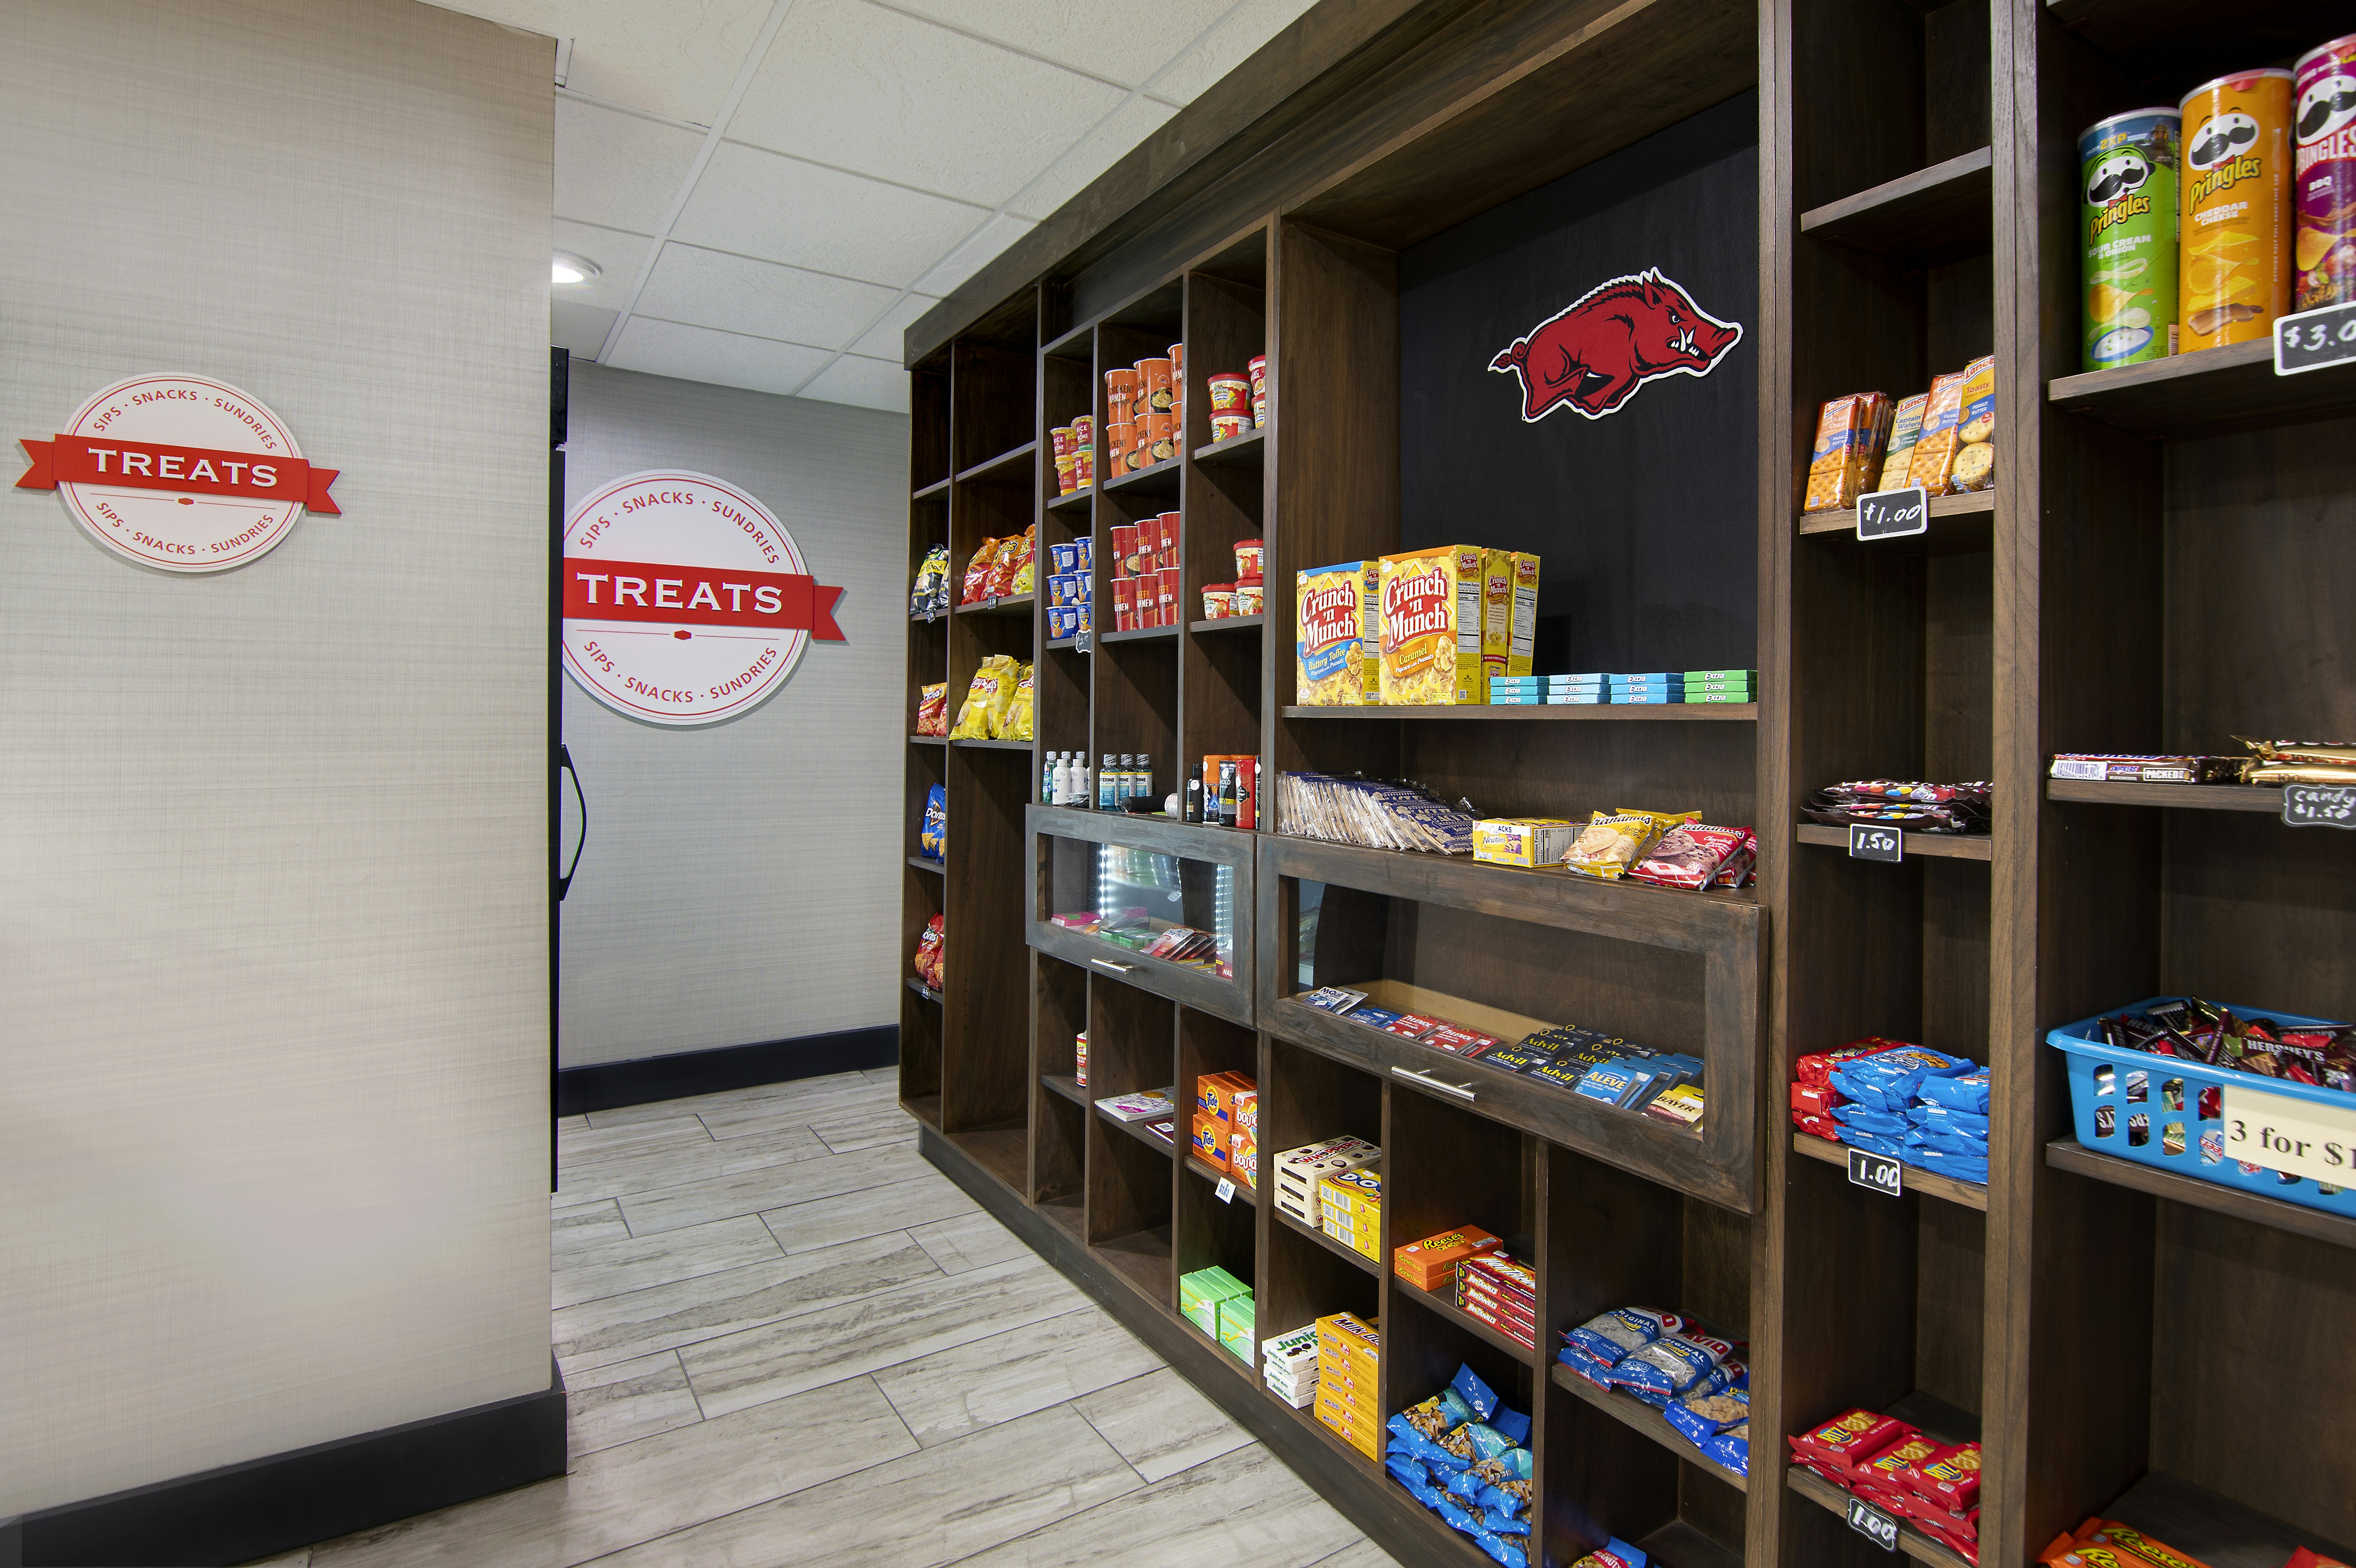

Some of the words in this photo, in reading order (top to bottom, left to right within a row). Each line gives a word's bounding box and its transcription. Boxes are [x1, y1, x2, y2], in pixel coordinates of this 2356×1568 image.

[2100, 133, 2127, 150] 2XP
[2189, 155, 2261, 216] Pringles
[2309, 176, 2332, 191] BBQ
[2090, 193, 2150, 246] Pringles
[2195, 201, 2248, 222] CHEDDAR
[2201, 211, 2239, 226] CHEESE
[2088, 243, 2110, 258] SOUR
[2112, 235, 2151, 248] CREAM
[2098, 250, 2104, 259] &
[2105, 244, 2136, 257] ONION
[1966, 358, 1994, 379] Lance
[1109, 385, 1132, 395] CHICKEN
[1967, 382, 1990, 394] Toasty
[1109, 394, 1126, 402] RAMEN
[1899, 396, 1928, 412] Lance
[1973, 401, 1988, 410] PEANUT
[94, 405, 122, 432] SIPS
[132, 389, 197, 406] SNACKS
[214, 398, 277, 450] SUNDRIES
[88, 447, 278, 487] TREATS
[97, 503, 123, 528] SIPS
[133, 532, 195, 554] SNACKS
[211, 514, 273, 553] SUNDRIES
[580, 516, 610, 548] SIPS
[622, 492, 694, 514] SNACKS
[712, 501, 780, 565] SUNDRIES
[1460, 553, 1477, 562] Crunch
[1462, 560, 1476, 570] Munch
[1520, 560, 1535, 569] Crunch
[1489, 576, 1507, 585] Crunch
[577, 572, 783, 614] TREATS
[1385, 570, 1446, 615] Crunch
[1490, 585, 1507, 595] Munch
[1302, 582, 1354, 623] Crunch
[1409, 598, 1422, 613] 'n
[1323, 608, 1335, 622] 'n
[1305, 612, 1354, 653] Munch
[1389, 602, 1446, 647] Munch
[1308, 658, 1328, 670] Buttery
[1329, 649, 1345, 662] Toffee
[1399, 643, 1427, 665] Caramel
[1329, 659, 1344, 668] Peanuts
[1396, 665, 1411, 674] Popcorn
[1417, 654, 1434, 664] Peanuts
[584, 641, 615, 673] SIPS
[624, 677, 693, 703] SNACKS
[710, 647, 777, 699] SUNDRIES
[2146, 770, 2178, 779] PACKED
[2294, 788, 2356, 810] candy
[2294, 805, 2351, 820] $1.50
[1483, 835, 1506, 844] Newtons
[1856, 832, 1895, 851] 1.50
[1403, 1015, 1434, 1028] TYLENOL
[1441, 1030, 1474, 1041] TYLENOL
[1524, 1038, 1560, 1051] Advil
[2247, 1040, 2326, 1062] HERSHEY'S
[1493, 1052, 1528, 1065] Advil
[1537, 1066, 1575, 1081] Advil
[1585, 1071, 1627, 1089] ALEVE
[1207, 1093, 1218, 1107] Tide
[1656, 1097, 1696, 1113] BAYER
[1203, 1131, 1214, 1145] Tide
[2230, 1120, 2247, 1142] 3
[2259, 1127, 2310, 1157] for
[1300, 1140, 1361, 1163] WHOPPERS
[1861, 1160, 1898, 1187] 1.00
[1423, 1233, 1465, 1250] Reese's
[1398, 1254, 1412, 1266] Reese's
[1398, 1267, 1413, 1279] Reese's
[1332, 1318, 1367, 1335] Milk
[1614, 1314, 1642, 1329] Jumbo
[1277, 1331, 1318, 1351] Junio
[1683, 1335, 1728, 1355] AVID
[1267, 1350, 1279, 1360] Junior
[1659, 1343, 1690, 1356] Jumbo
[1269, 1372, 1280, 1382] Junior
[1272, 1383, 1284, 1394] Junior
[1816, 1426, 1851, 1444] RITZ
[1873, 1455, 1909, 1471] RITZ
[1923, 1462, 1961, 1481] RITZ
[1852, 1506, 1897, 1542] 1.00
[1592, 1551, 1622, 1568] PEANUTS
